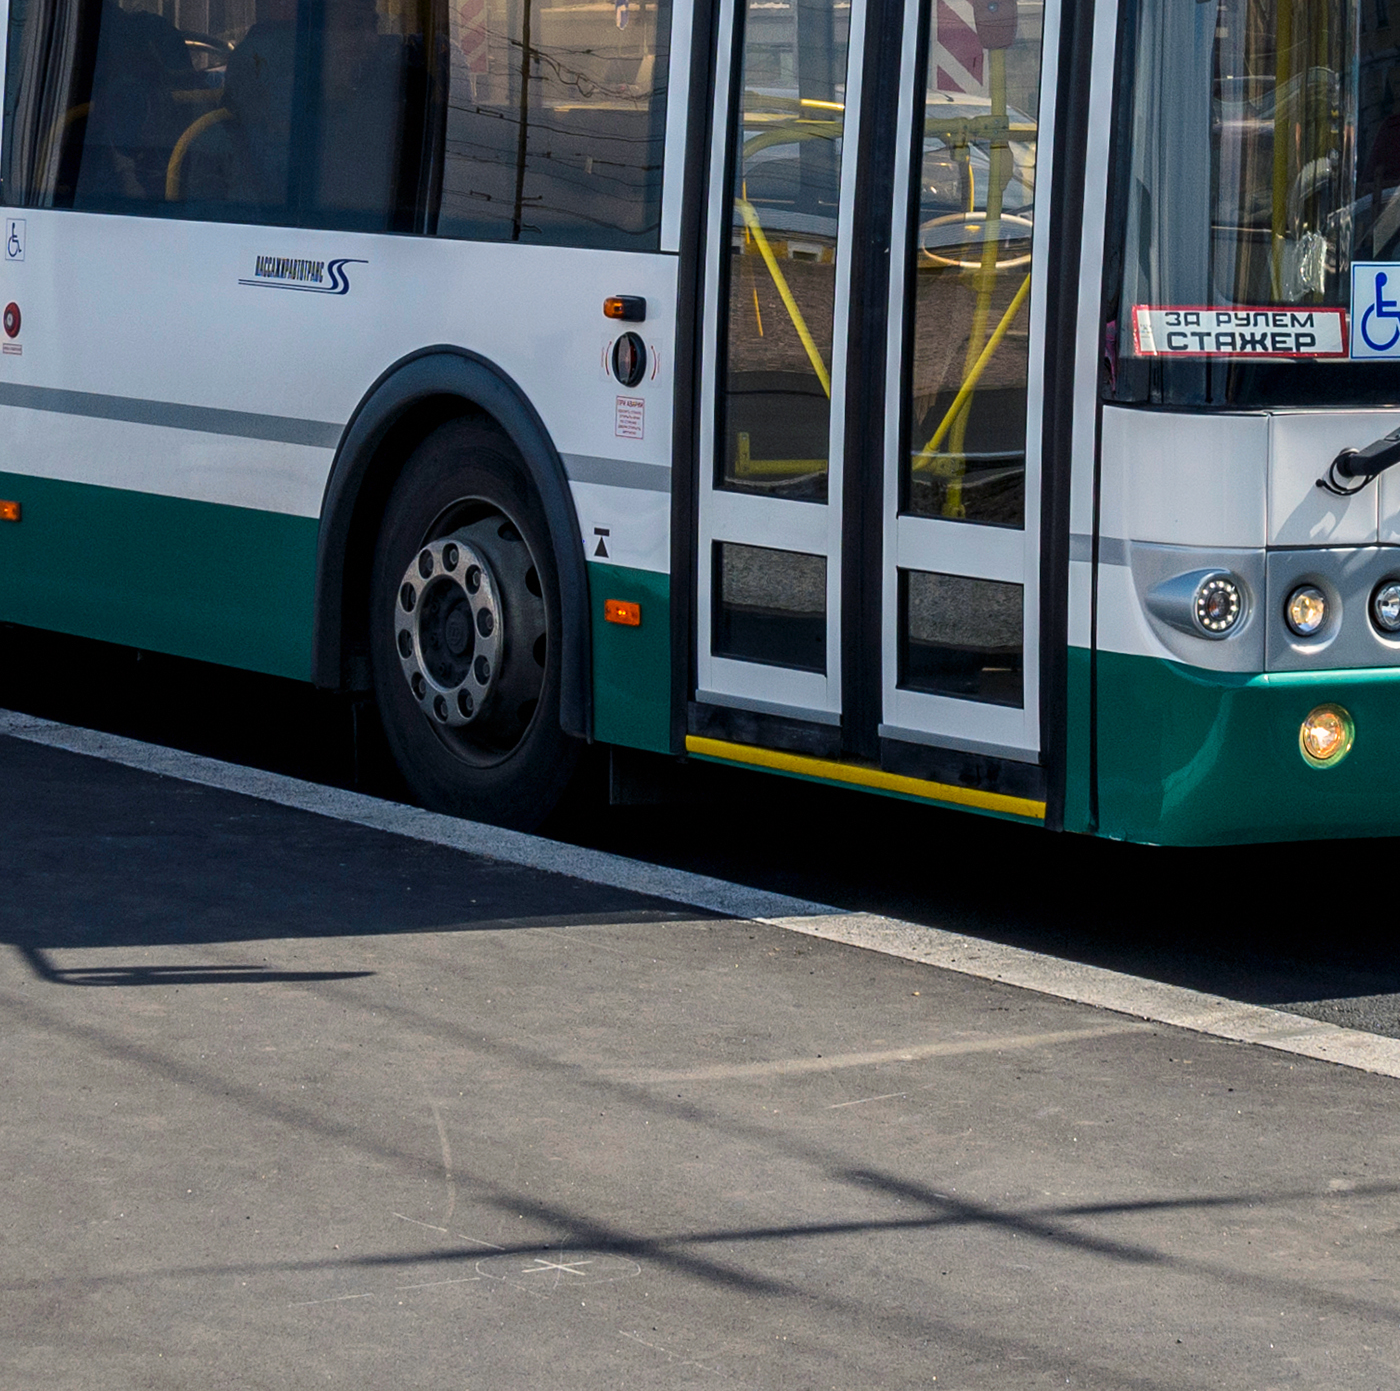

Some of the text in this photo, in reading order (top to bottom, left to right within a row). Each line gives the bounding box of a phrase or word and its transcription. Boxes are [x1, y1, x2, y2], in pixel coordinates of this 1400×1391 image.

[1165, 311, 1315, 329] ЗА РУЛЕМ
[1166, 331, 1316, 352] СТАЖЕР
